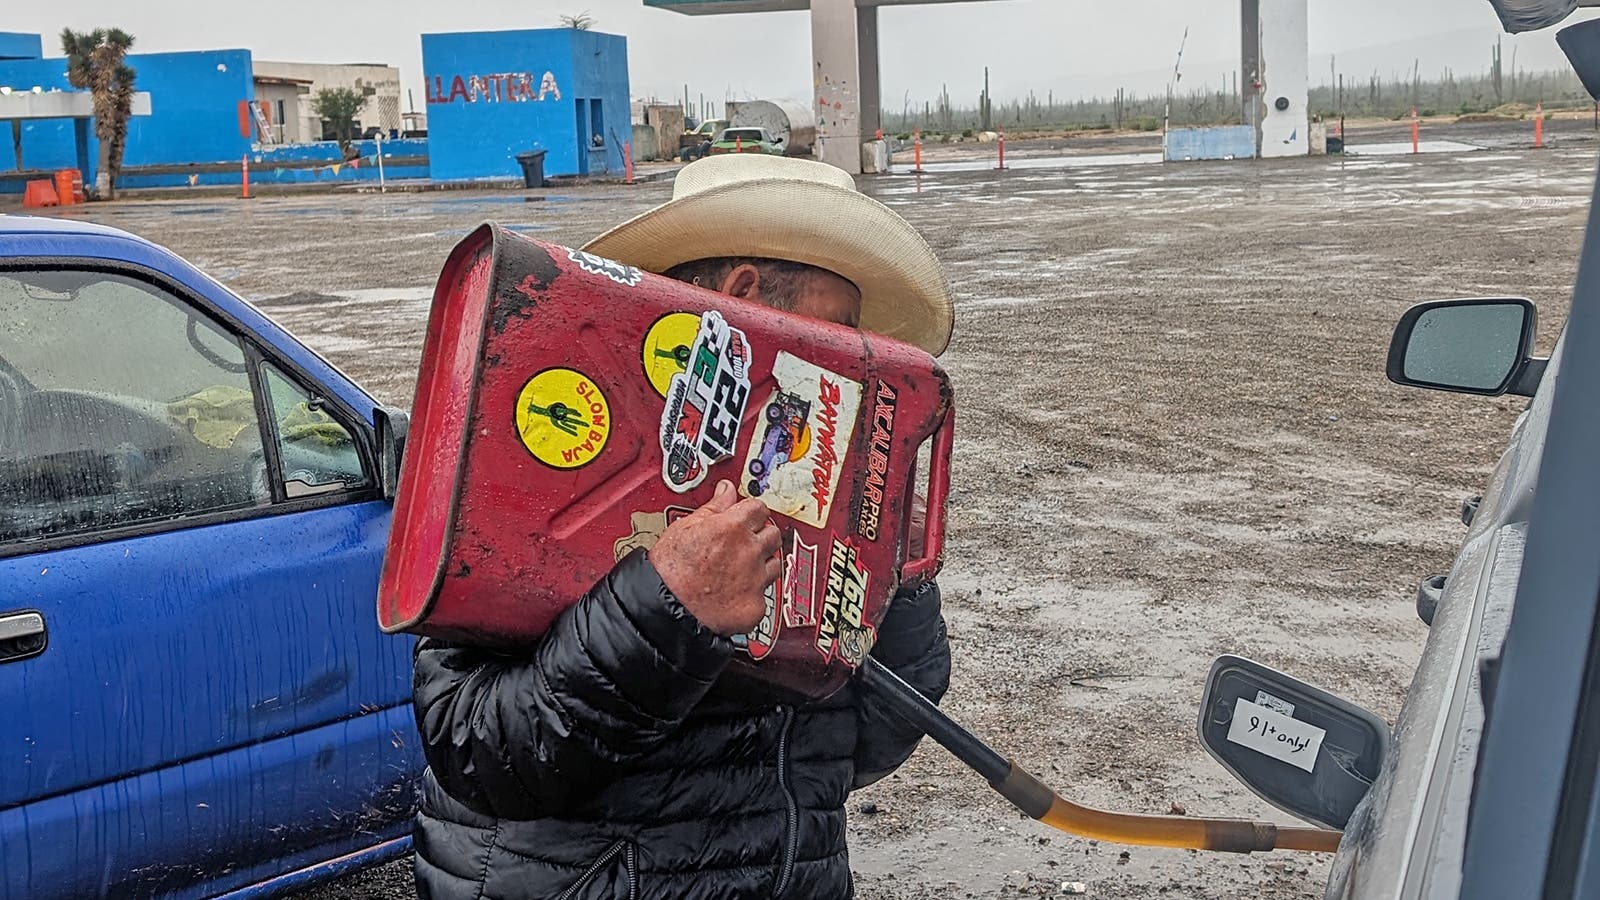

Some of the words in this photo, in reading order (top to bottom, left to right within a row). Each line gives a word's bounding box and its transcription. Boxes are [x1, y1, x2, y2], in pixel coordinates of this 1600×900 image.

[424, 70, 561, 104] LLANTERA
[732, 355, 744, 379] 1000
[575, 381, 606, 428] SLOW
[662, 378, 687, 453] MOTORSPORTS
[561, 429, 603, 463] BAJA
[817, 539, 849, 655] HURACAN
[840, 559, 869, 630] 769
[1277, 733, 1311, 754] only!
